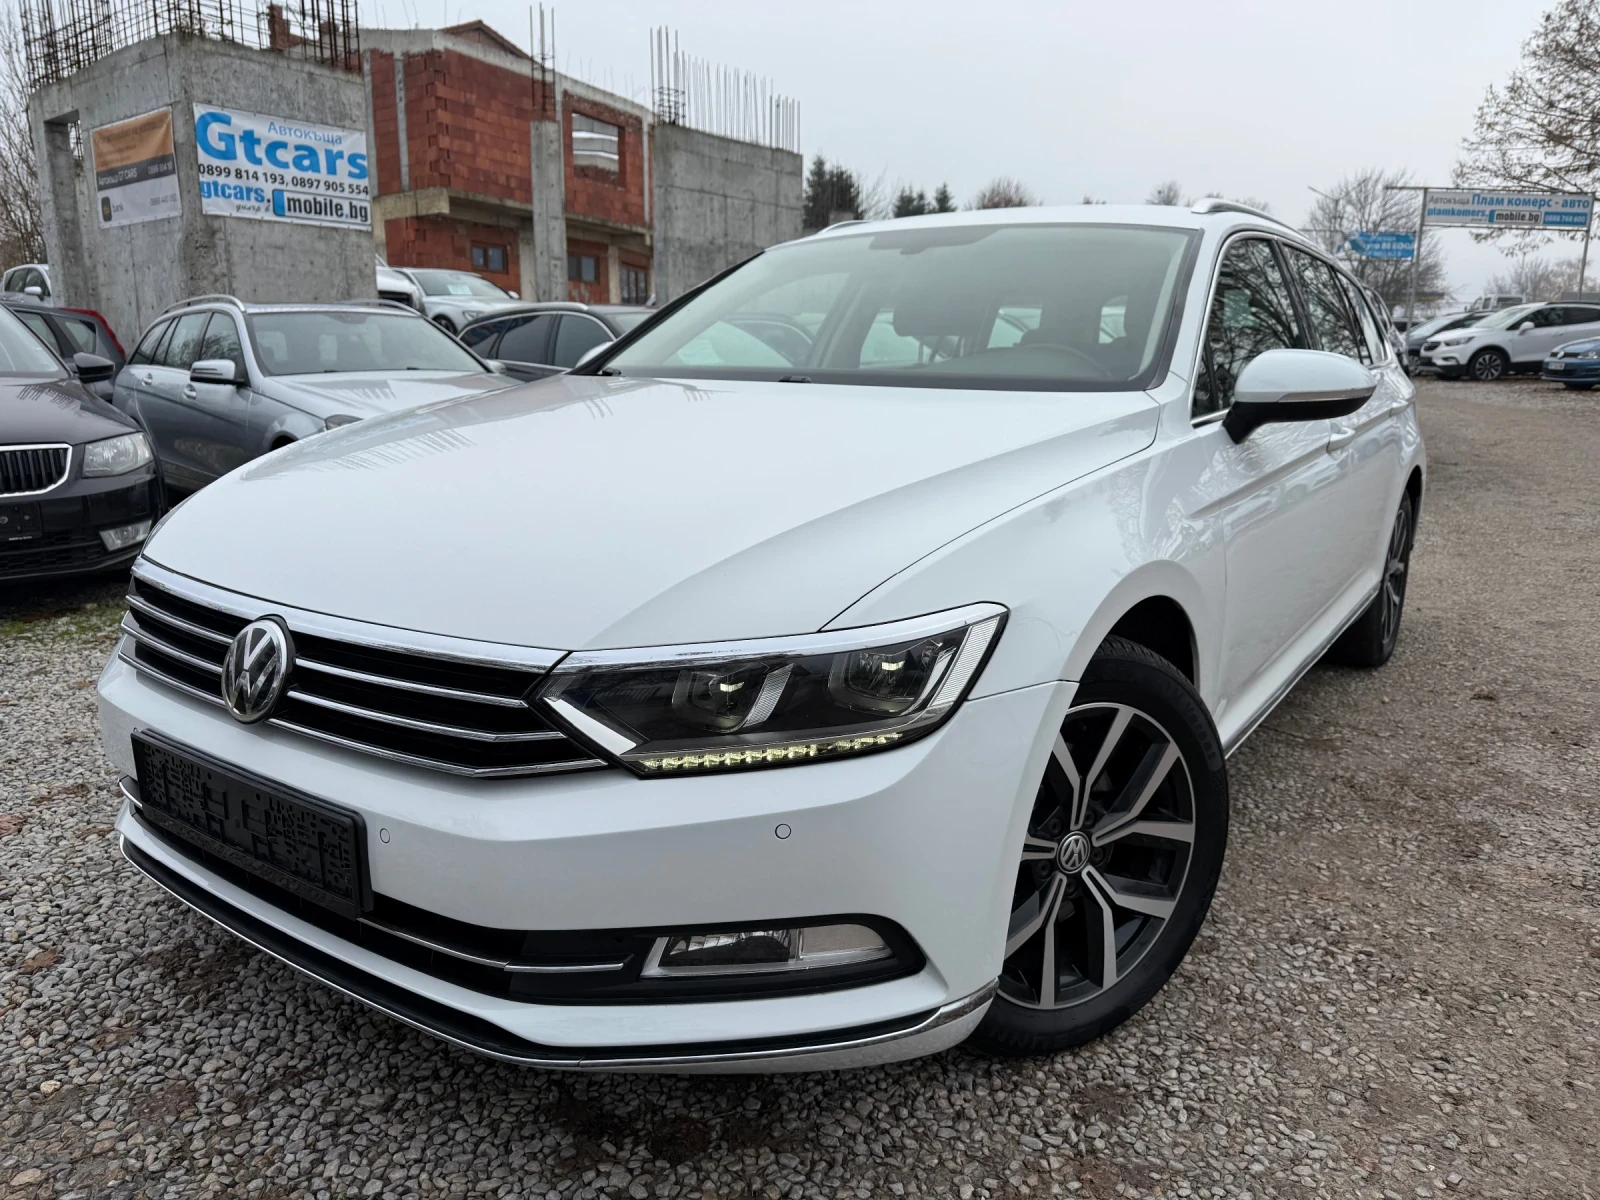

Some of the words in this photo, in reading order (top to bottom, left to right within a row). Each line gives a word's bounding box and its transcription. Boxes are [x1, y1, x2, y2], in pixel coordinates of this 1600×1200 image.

[195, 112, 368, 179] Gtcars
[268, 121, 342, 146] Автокъща
[124, 167, 137, 179] CARS
[198, 163, 231, 178] 0899
[235, 168, 259, 181] 814
[262, 172, 288, 187] 193,
[291, 176, 321, 189] 0897
[324, 180, 345, 193] 905
[348, 184, 369, 195] 554
[287, 197, 369, 222] mobile.bg
[1471, 193, 1504, 206] Плам
[1507, 197, 1552, 209] комерс
[1561, 199, 1590, 209] авто
